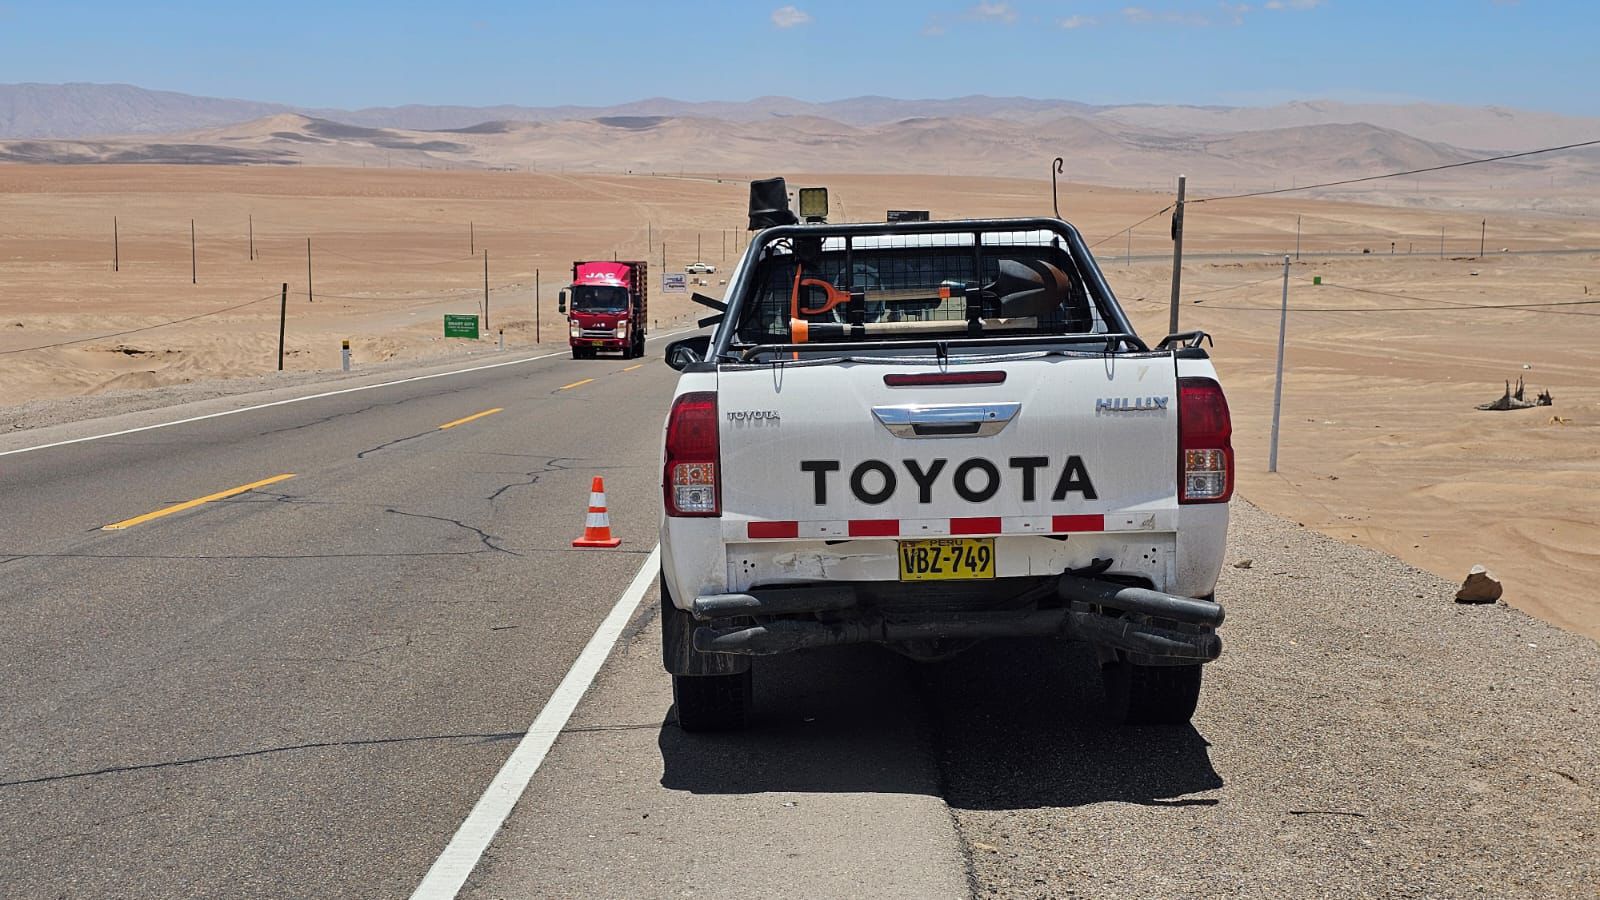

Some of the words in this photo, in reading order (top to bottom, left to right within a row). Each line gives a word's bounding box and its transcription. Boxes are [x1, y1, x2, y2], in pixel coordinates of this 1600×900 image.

[1096, 396, 1169, 412] HILUX
[727, 410, 781, 421] TOYOTA
[800, 455, 1098, 505] TOYOTA
[929, 538, 963, 547] PERU
[903, 545, 991, 574] VBZ-749
